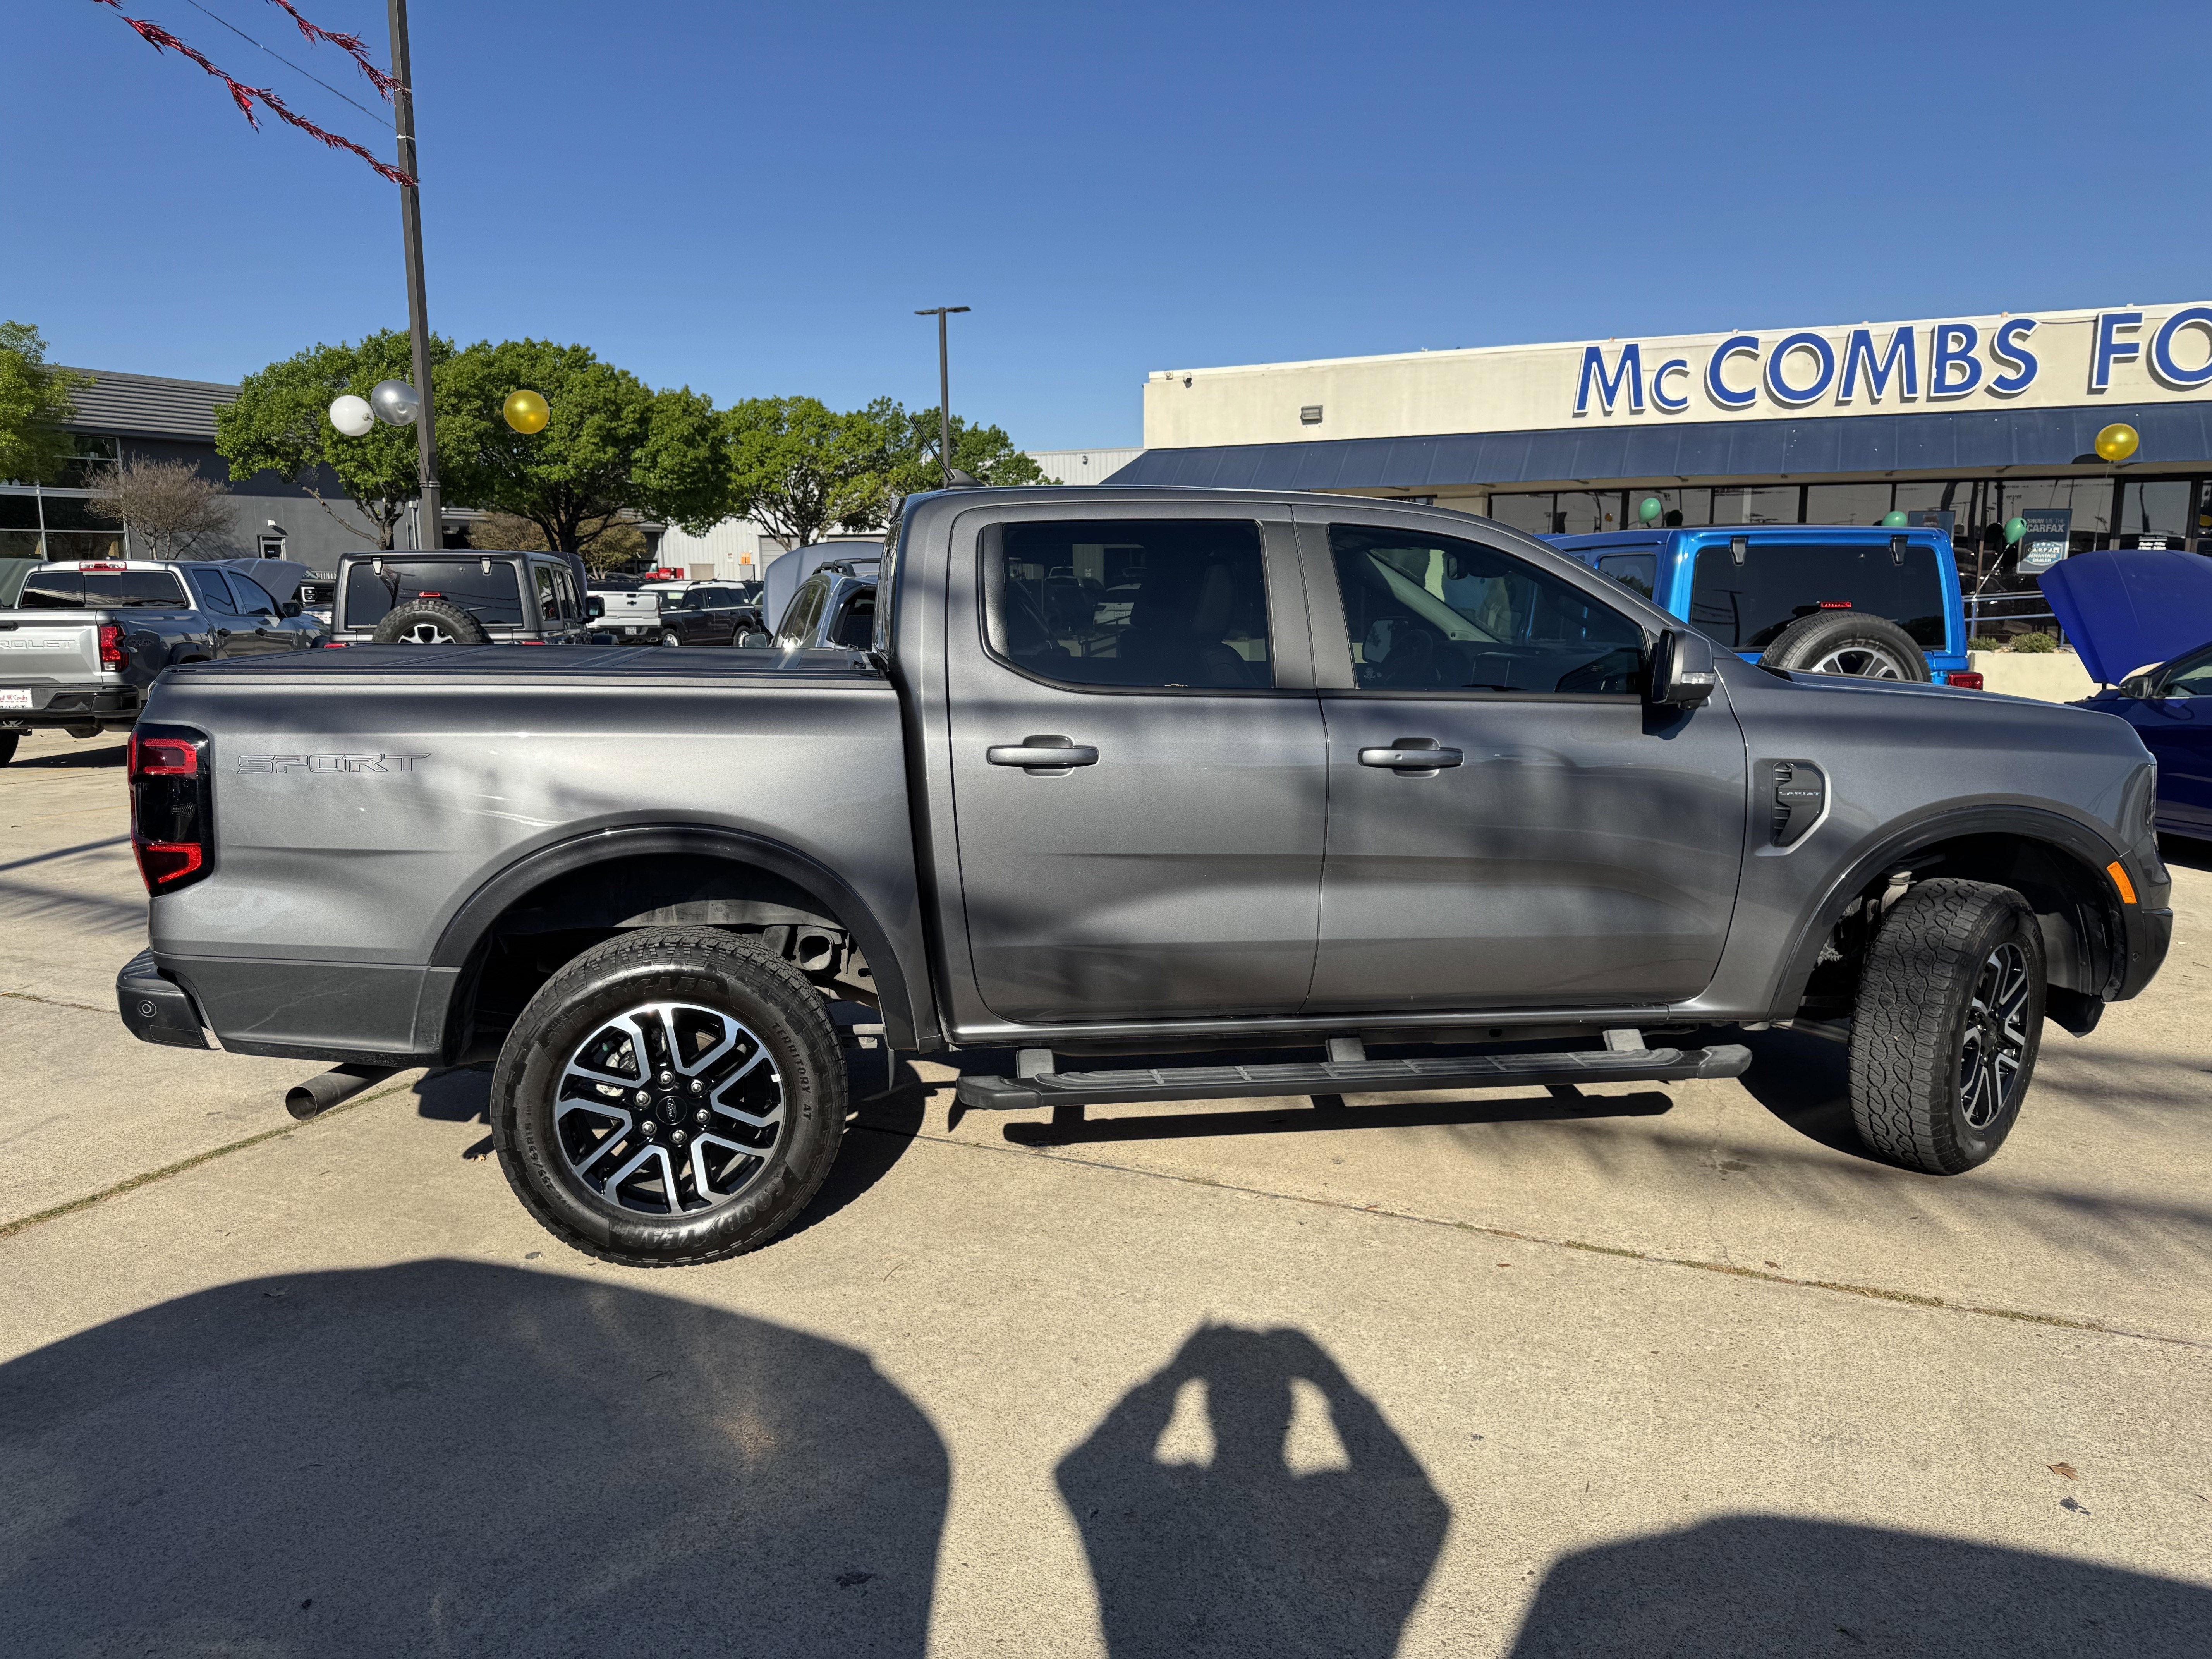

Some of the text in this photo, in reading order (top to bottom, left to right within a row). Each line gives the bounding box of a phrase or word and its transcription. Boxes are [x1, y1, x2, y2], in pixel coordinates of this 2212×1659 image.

[2027, 524, 2064, 532] CARFAX
[236, 753, 432, 774] SPORT
[772, 1022, 811, 1093] TERRITORY
[802, 1104, 812, 1120] AT
